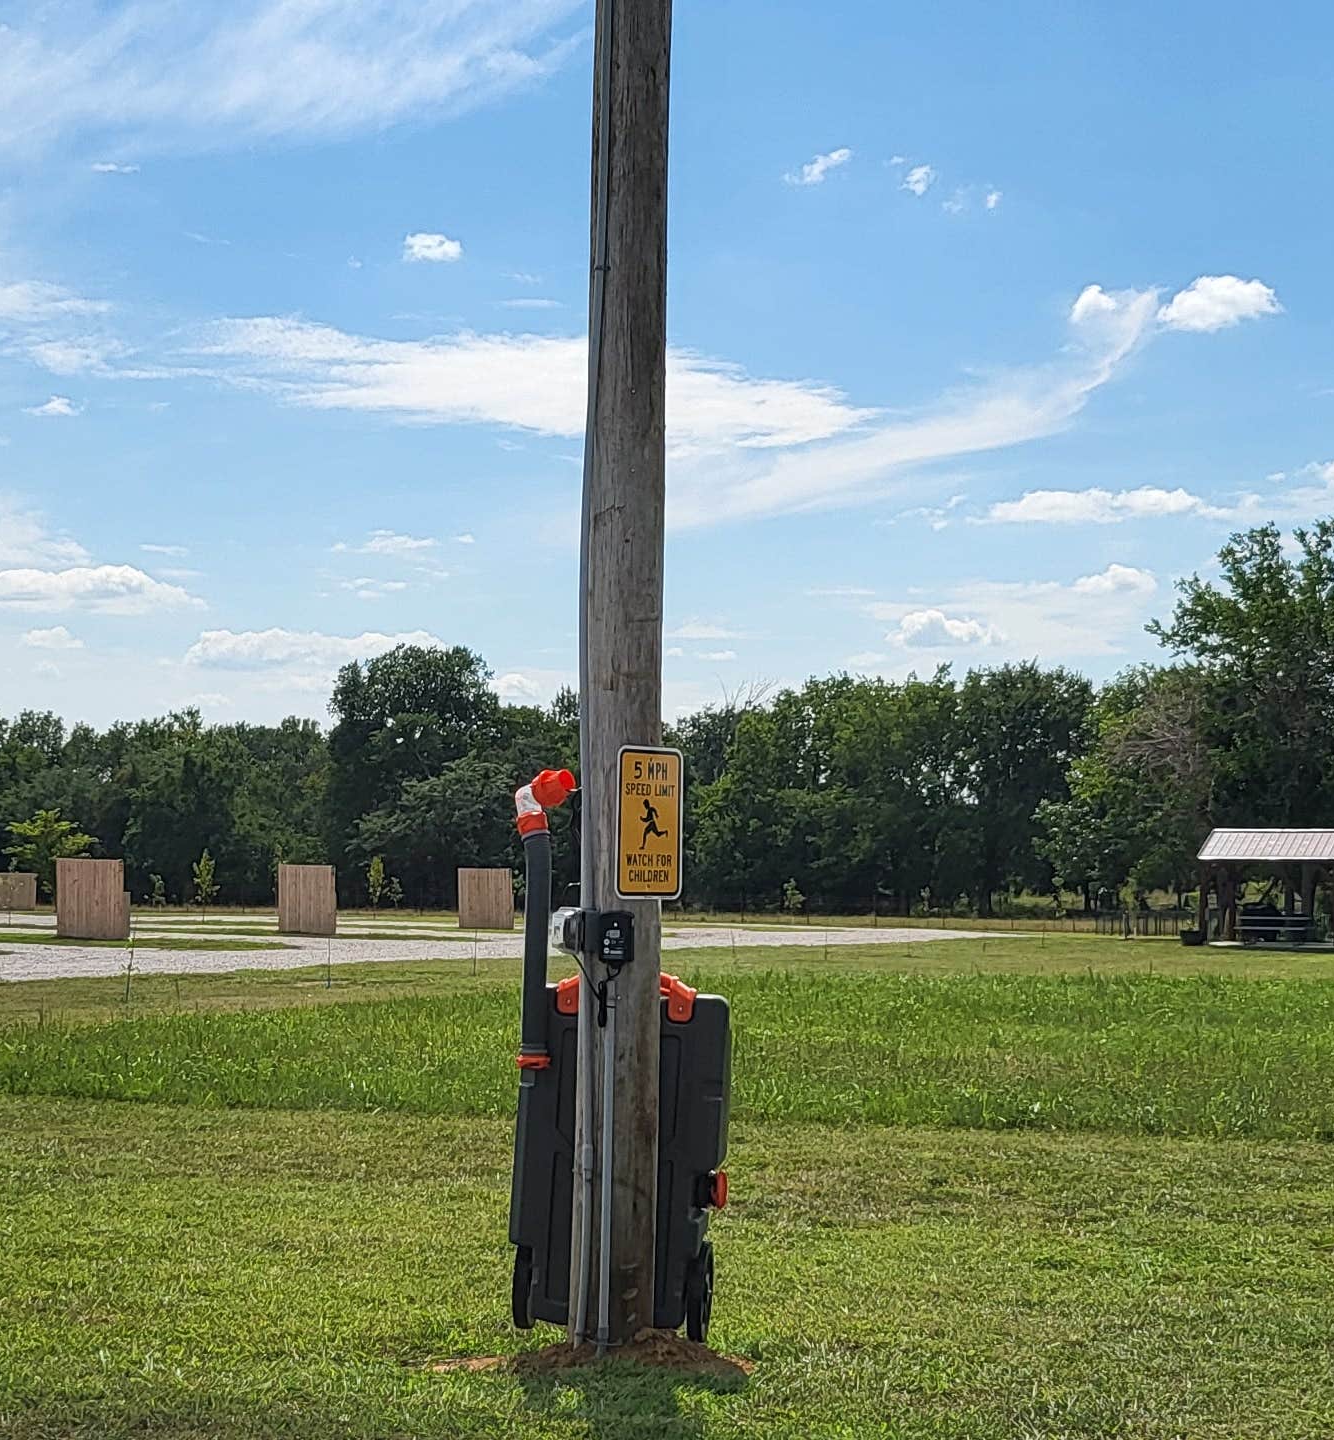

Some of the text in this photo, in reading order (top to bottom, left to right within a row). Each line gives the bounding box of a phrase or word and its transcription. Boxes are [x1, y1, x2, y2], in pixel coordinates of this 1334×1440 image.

[634, 761, 667, 780] 5 MPH
[625, 782, 675, 797] SPEED LIMIT
[626, 854, 672, 867] WATCH FOR
[628, 869, 669, 882] CHILDREN
